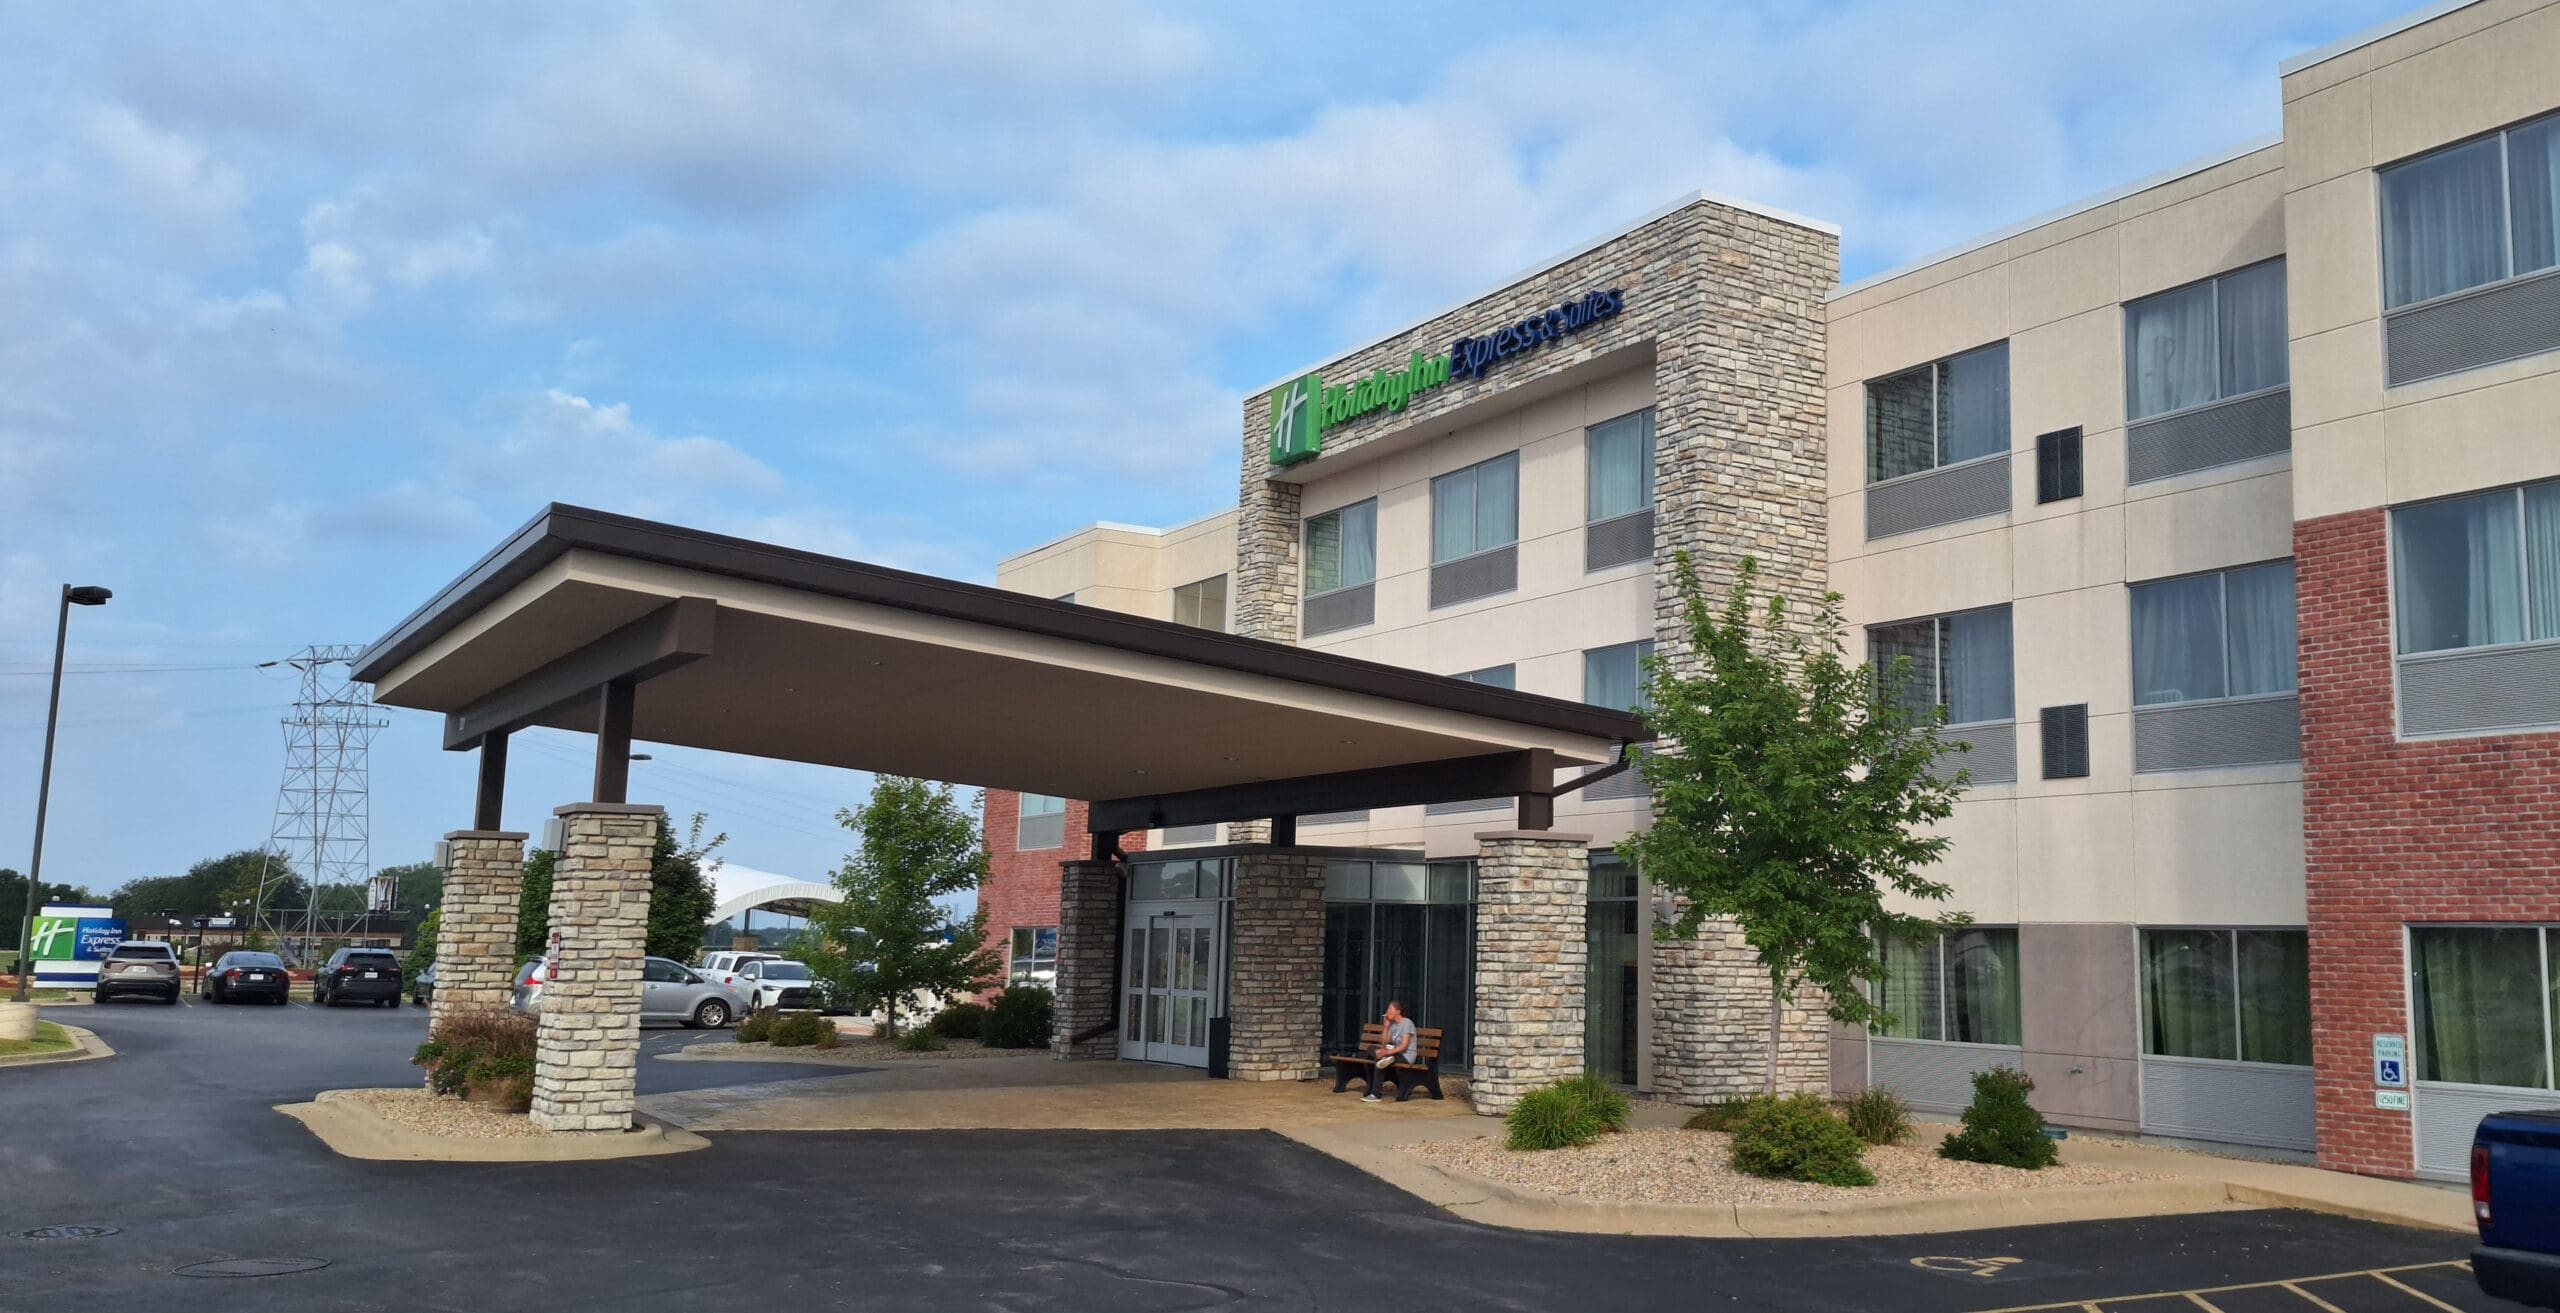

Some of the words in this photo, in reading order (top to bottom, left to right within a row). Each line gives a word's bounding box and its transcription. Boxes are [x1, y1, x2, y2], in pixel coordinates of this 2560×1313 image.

[1450, 315, 1543, 379] Express
[1539, 309, 1562, 340] &
[1559, 287, 1625, 332] Suites
[80, 934, 122, 946] Express
[2378, 1049, 2401, 1057] PARKING
[2393, 1095, 2406, 1106] FINE
